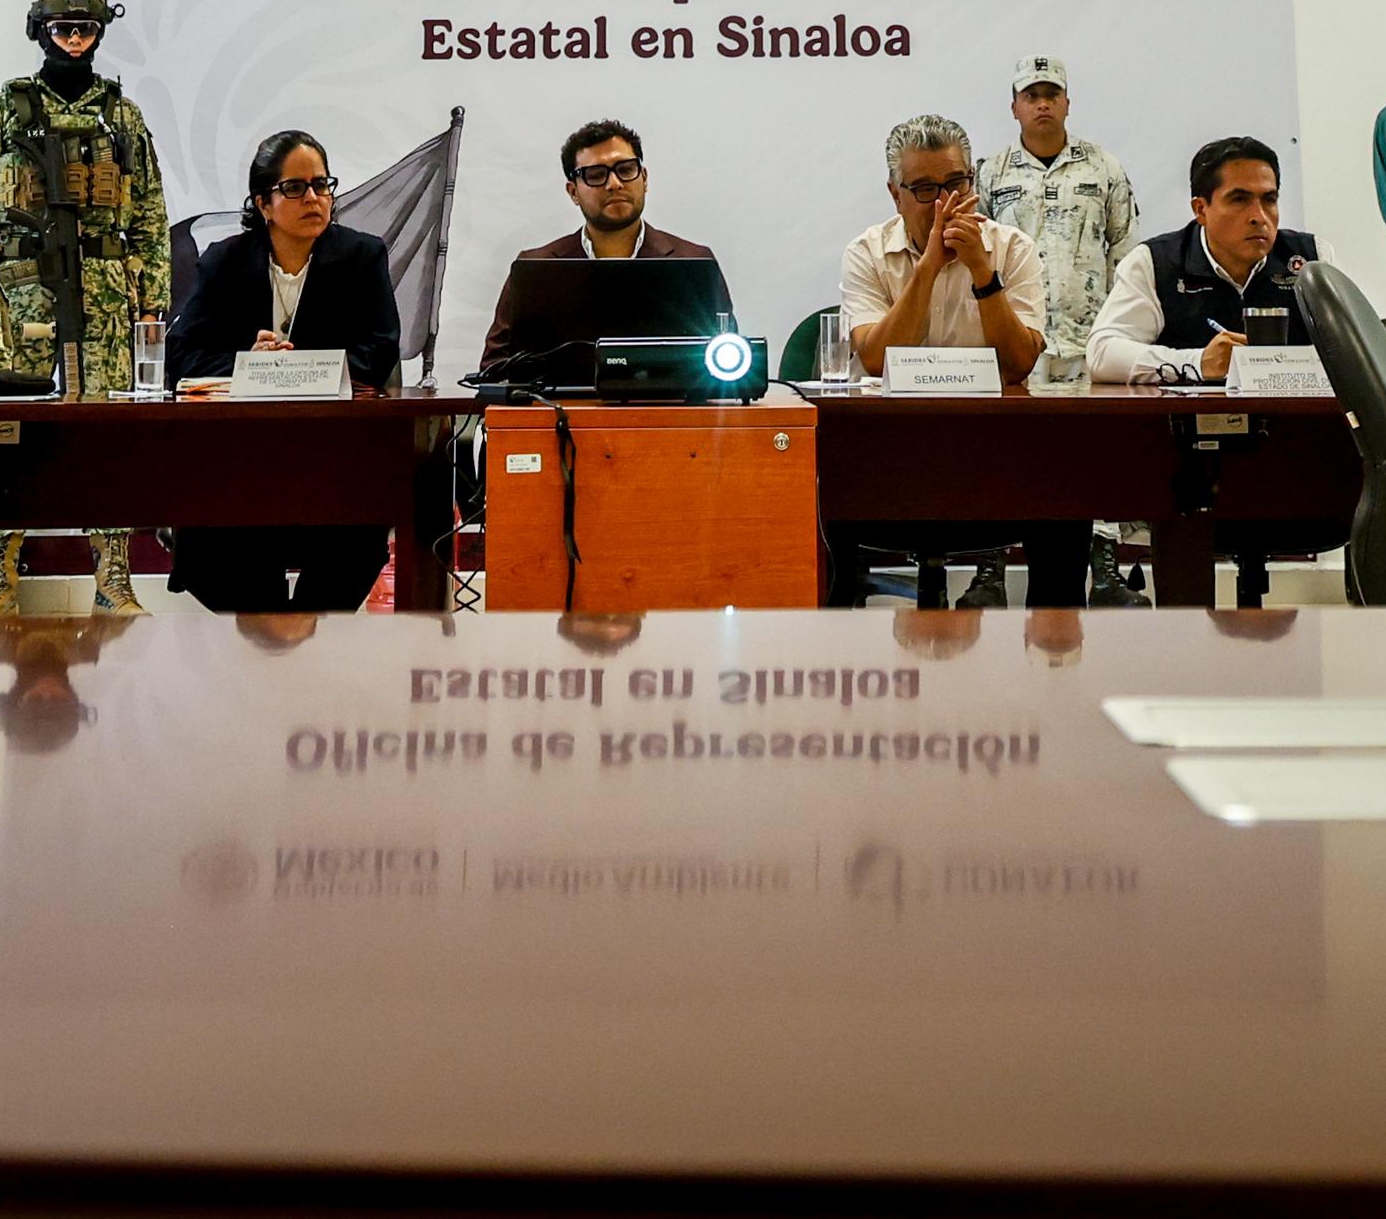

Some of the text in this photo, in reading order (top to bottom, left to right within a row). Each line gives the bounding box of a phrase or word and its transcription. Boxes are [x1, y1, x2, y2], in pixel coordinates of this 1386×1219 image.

[421, 13, 911, 61] Estatal en Sinaloa
[914, 374, 976, 384] SEMARNAT
